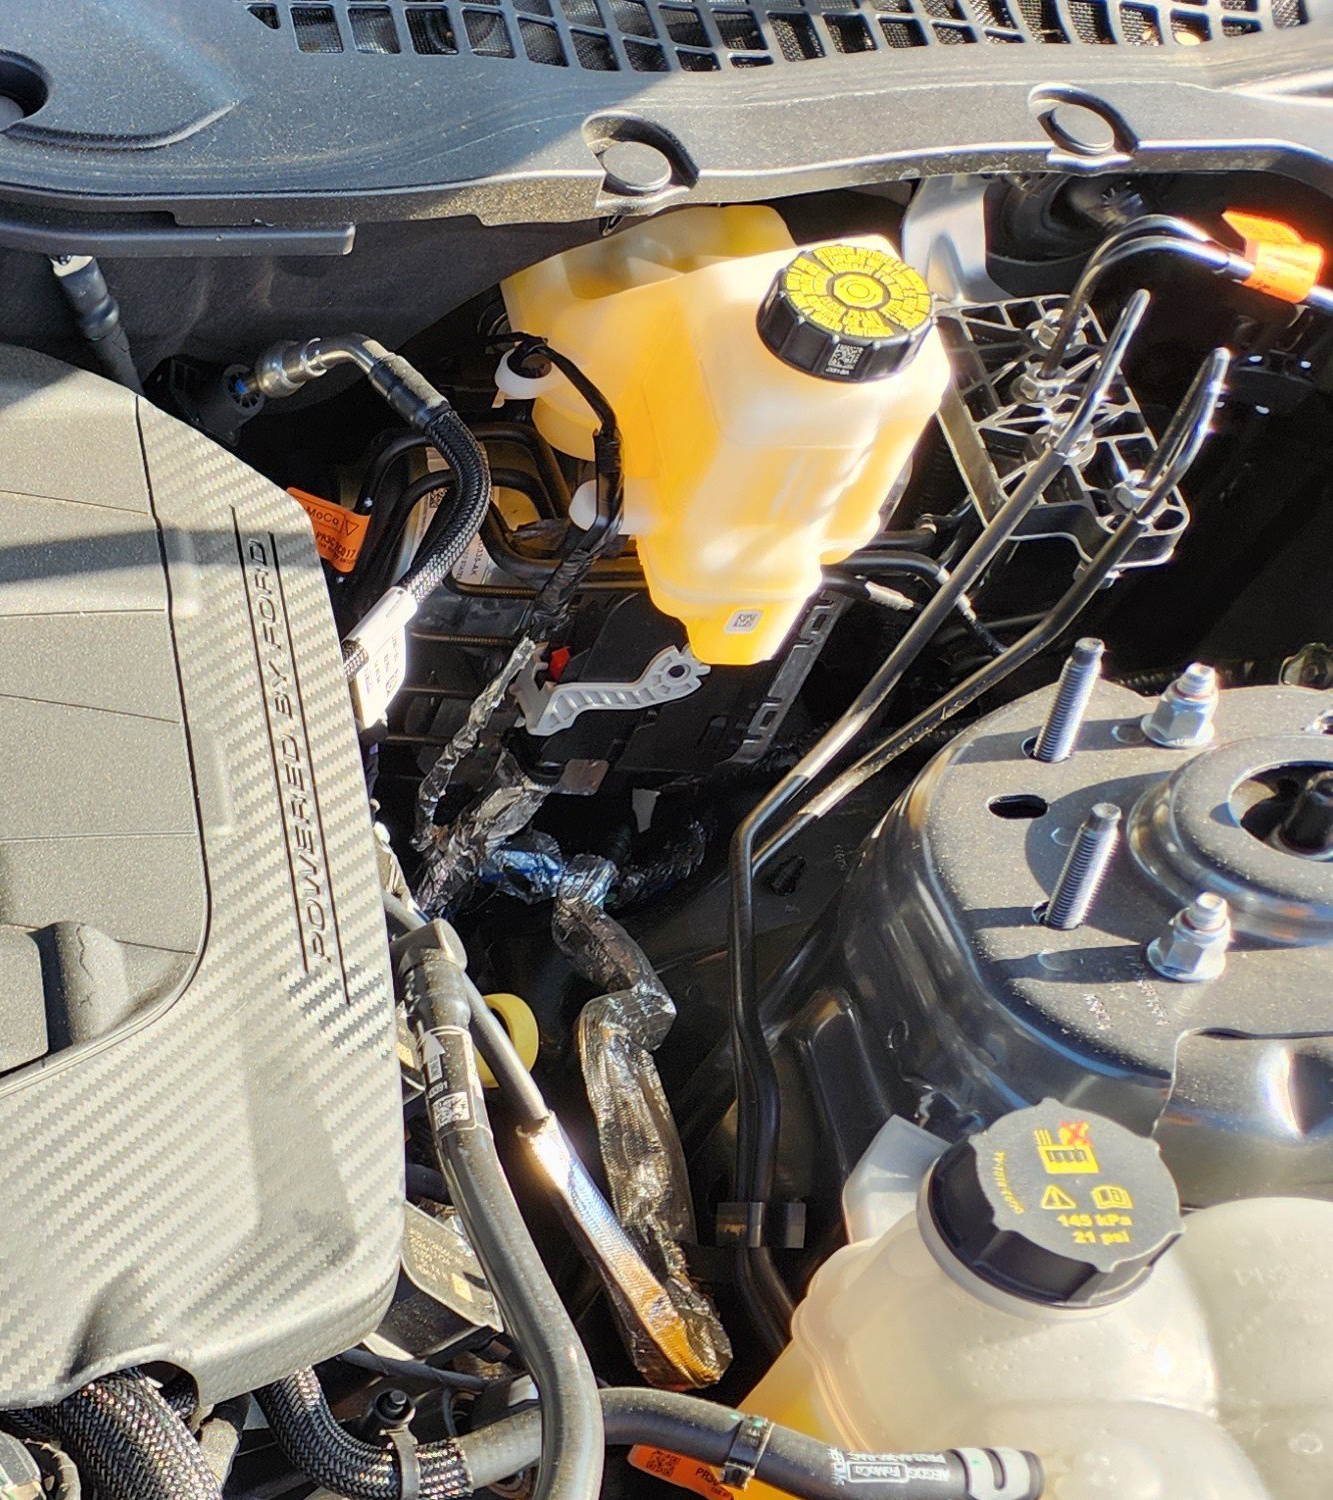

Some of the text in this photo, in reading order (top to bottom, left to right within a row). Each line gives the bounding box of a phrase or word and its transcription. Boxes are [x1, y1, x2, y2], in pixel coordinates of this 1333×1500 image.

[249, 536, 333, 965] POWERED BY FORD
[1072, 1230, 1096, 1243] 21
